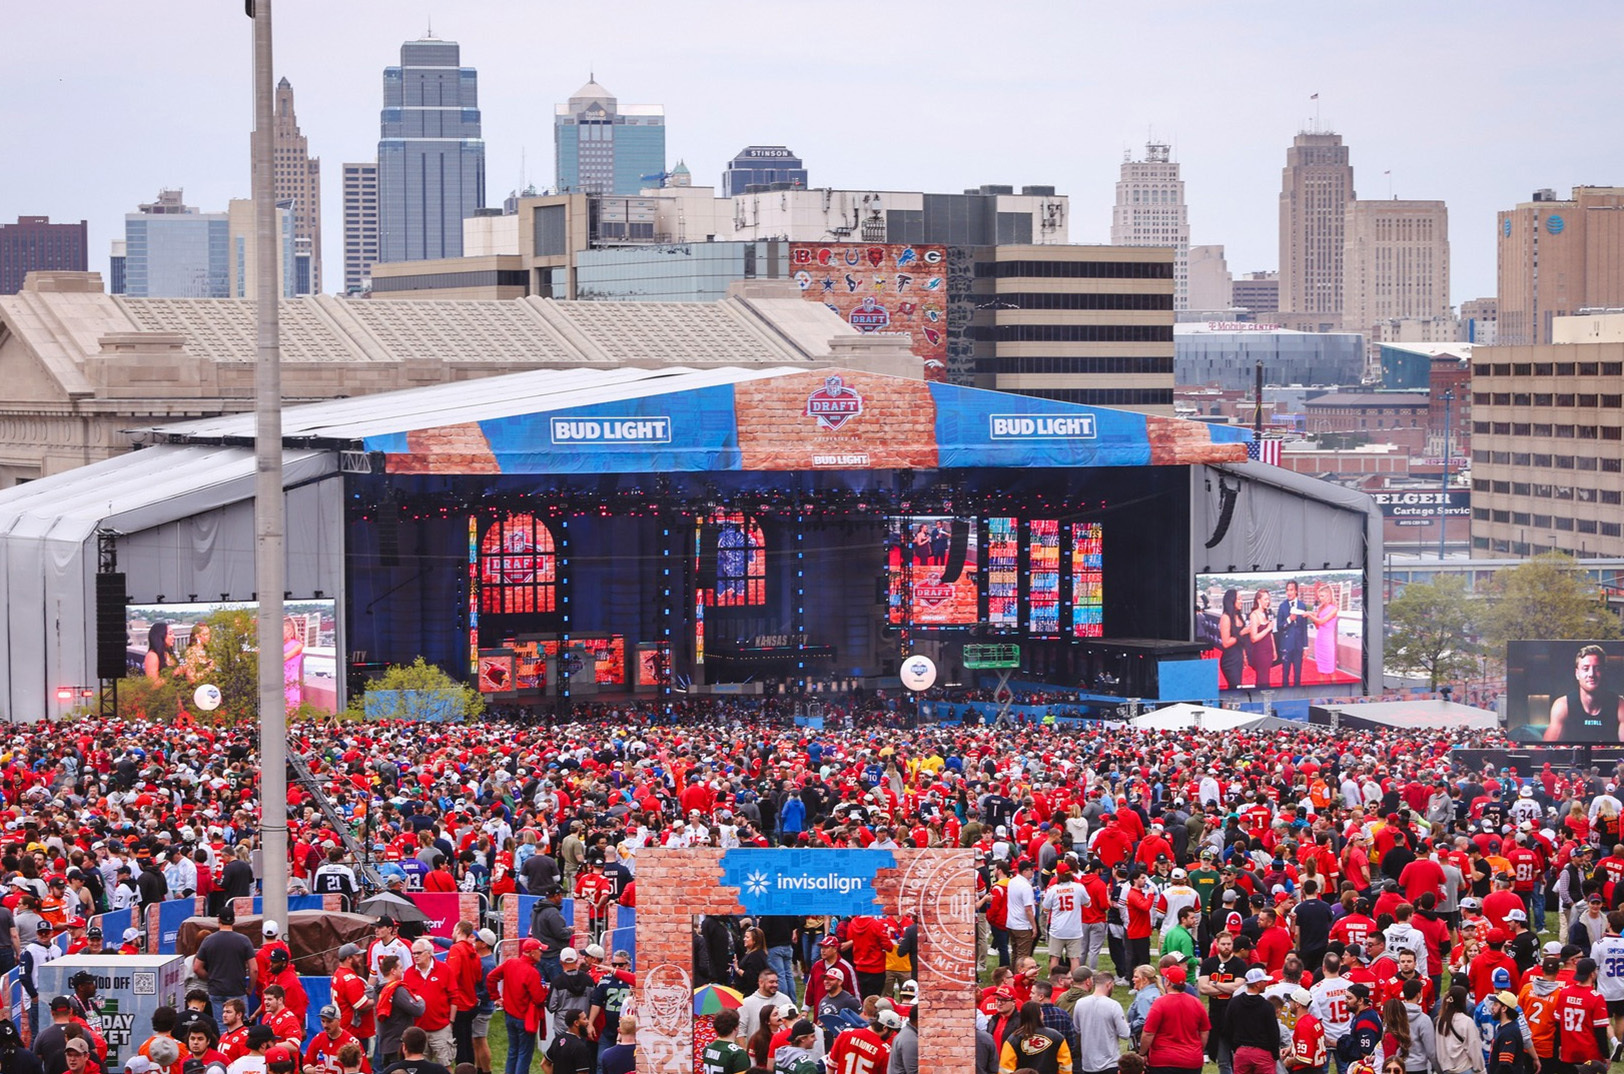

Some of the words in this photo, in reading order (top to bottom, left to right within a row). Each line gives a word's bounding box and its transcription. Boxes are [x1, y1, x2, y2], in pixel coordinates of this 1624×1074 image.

[750, 150, 789, 158] STINSON
[852, 315, 885, 323] DRAFT
[812, 402, 857, 411] DRAFT
[555, 421, 602, 439] BUD
[603, 420, 667, 439] LIGHT
[993, 418, 1036, 435] BUD
[1037, 417, 1093, 435] LIGHT
[813, 456, 836, 465] BUD
[837, 455, 867, 464] LIGHT
[1393, 507, 1435, 517] Cartage
[1437, 506, 1470, 515] Servic
[754, 635, 788, 647] KANSAS
[352, 651, 368, 662] ITY
[868, 773, 878, 782] 10
[992, 804, 998, 817] 1
[1518, 808, 1533, 824] 34
[1256, 815, 1264, 829] 1
[1516, 863, 1533, 881] 81
[326, 875, 342, 891] 21
[777, 873, 863, 894] invisalign
[907, 852, 942, 917] ATIONAL
[1058, 895, 1075, 911] 15
[1347, 931, 1367, 947] 15
[934, 955, 962, 975] NFL
[1605, 957, 1624, 978] 32
[95, 976, 112, 990] 100
[113, 976, 131, 990] OFF
[1325, 989, 1347, 998] MAHOME
[986, 1002, 999, 1010] KEL
[1329, 1000, 1351, 1023] 15
[1529, 1001, 1544, 1025] 2
[102, 1014, 135, 1030] DAY
[1563, 1007, 1586, 1032] 87
[849, 1035, 879, 1056] MAHOMES
[1360, 1038, 1371, 1047] 99
[844, 1051, 875, 1074] 15
